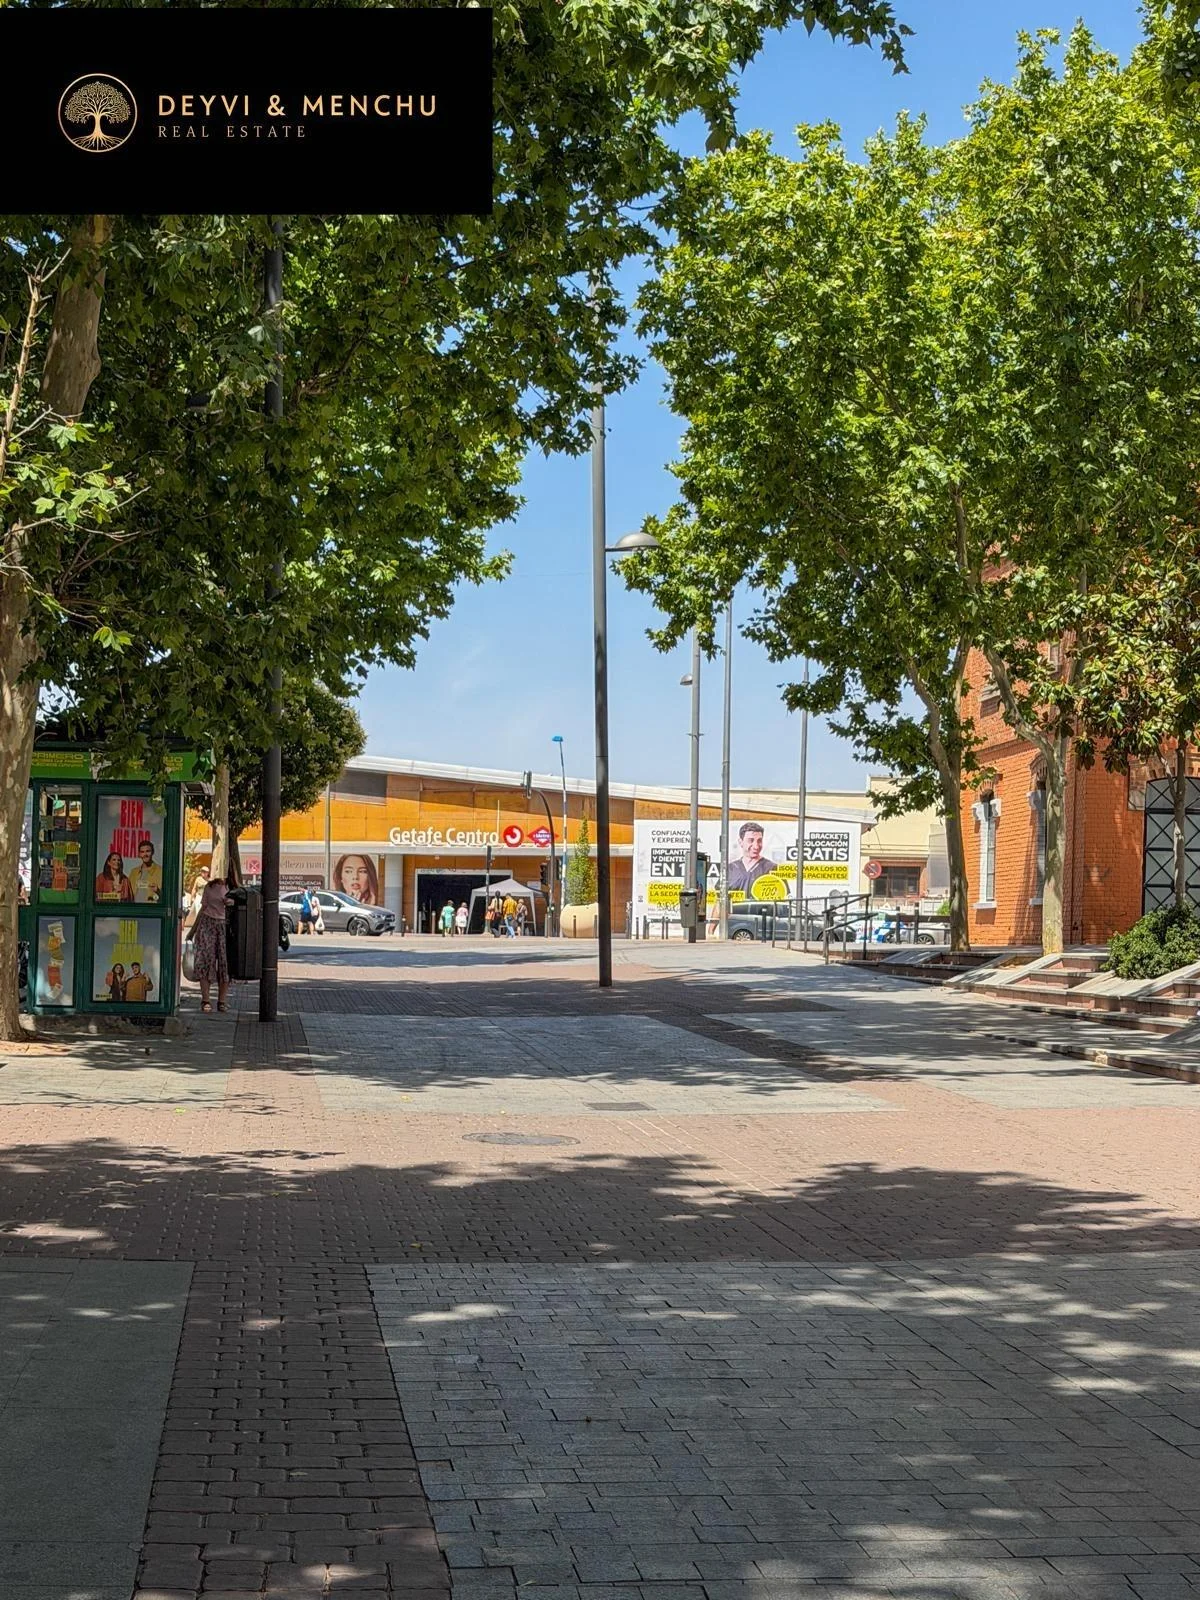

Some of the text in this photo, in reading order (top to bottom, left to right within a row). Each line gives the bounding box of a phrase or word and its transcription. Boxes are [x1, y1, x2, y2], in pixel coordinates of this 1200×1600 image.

[120, 799, 144, 828] BIEN
[389, 826, 499, 845] Getafe Centro
[787, 847, 848, 861] GRATIS
[652, 862, 675, 876] EN
